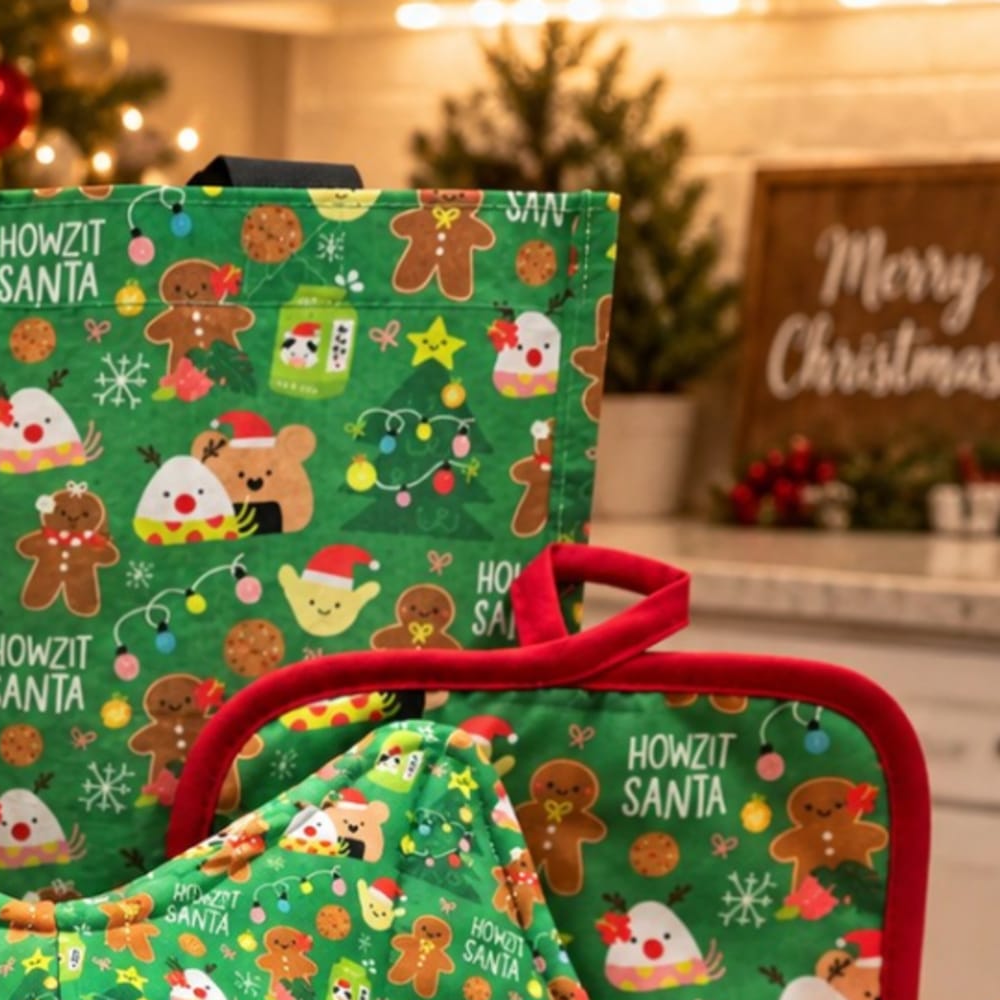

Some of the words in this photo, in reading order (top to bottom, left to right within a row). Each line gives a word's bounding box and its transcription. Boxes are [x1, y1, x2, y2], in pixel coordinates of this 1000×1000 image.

[0, 219, 106, 258] HOWZIT
[815, 223, 993, 335] Merry
[476, 560, 521, 595] HO
[627, 732, 738, 771] HOWZIT
[621, 773, 728, 820] SANTA
[164, 904, 230, 937] SANTA
[462, 938, 520, 982] SANTA
